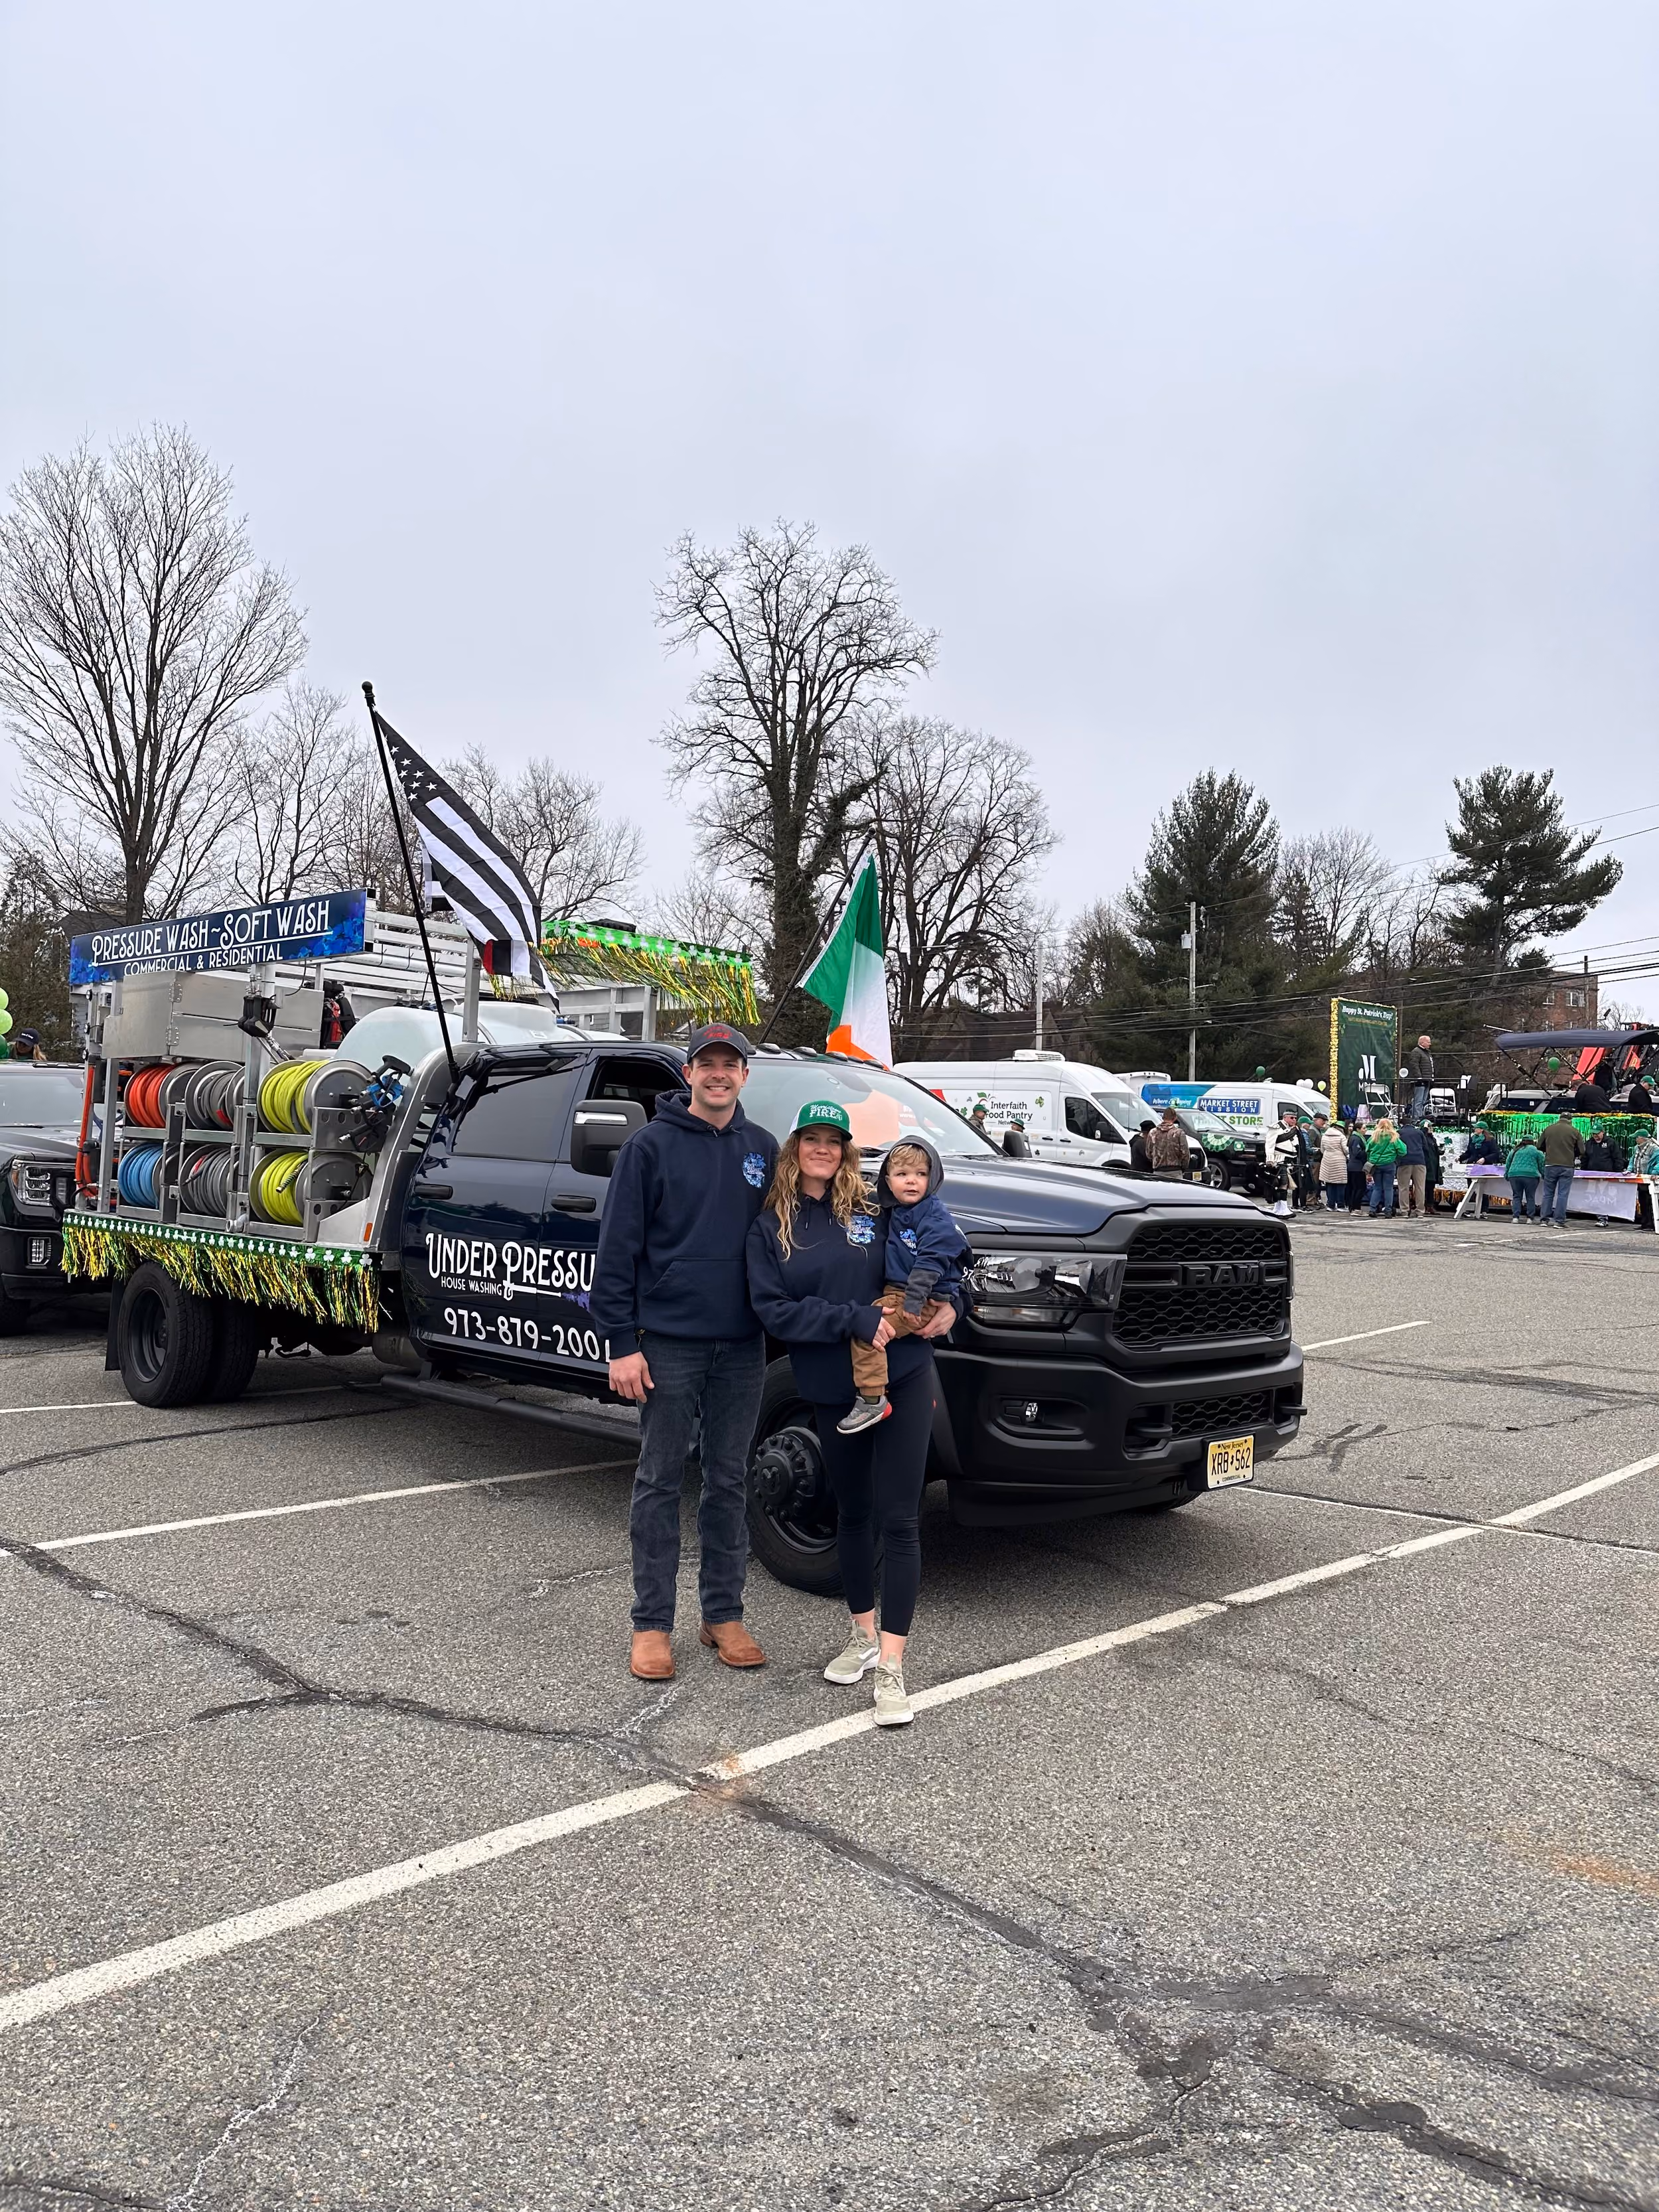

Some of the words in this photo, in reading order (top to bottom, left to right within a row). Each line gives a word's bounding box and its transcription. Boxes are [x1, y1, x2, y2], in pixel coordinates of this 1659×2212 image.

[92, 927, 163, 966] PRESSURE
[275, 900, 330, 936] WASH
[124, 955, 192, 976] COMMERCIAL
[196, 956, 204, 969] &
[208, 944, 283, 968] RESIDENTIAL
[1342, 1005, 1357, 1015] Happy
[991, 1101, 1027, 1110] Interfaith
[1200, 1098, 1229, 1107] MARKET
[810, 1108, 837, 1120] FIRE
[1007, 1110, 1033, 1121] Pantry
[425, 1233, 497, 1279] UNDER
[502, 1241, 596, 1291] PRESSU
[1187, 1264, 1259, 1286] RAM
[441, 1276, 466, 1291] HOUSE
[469, 1279, 502, 1296] WASHING
[1231, 1441, 1244, 1450] Jersey
